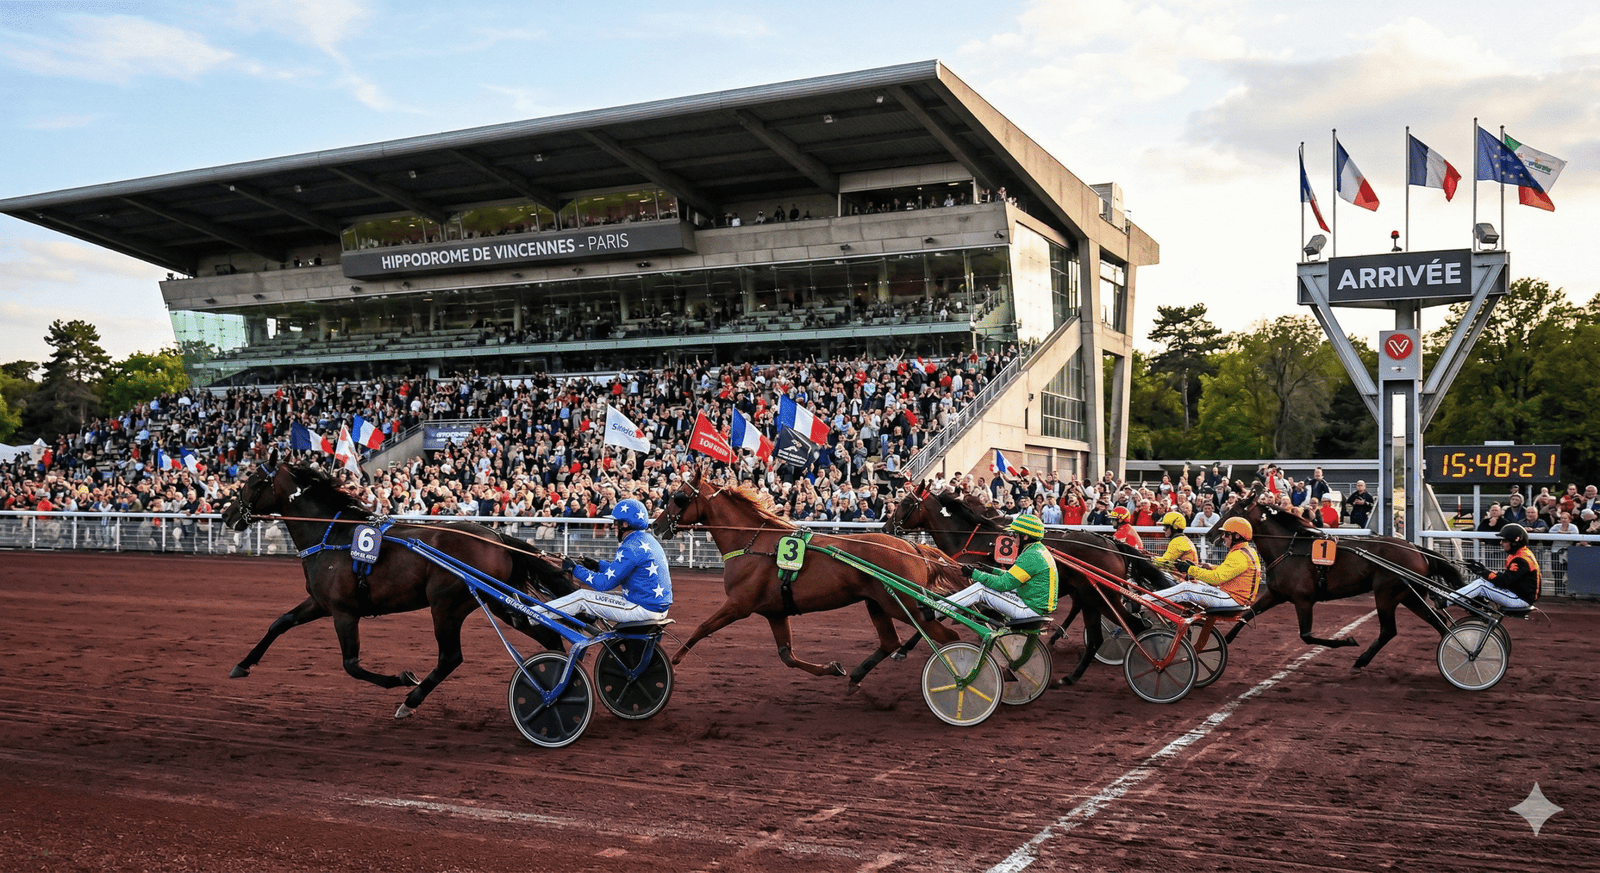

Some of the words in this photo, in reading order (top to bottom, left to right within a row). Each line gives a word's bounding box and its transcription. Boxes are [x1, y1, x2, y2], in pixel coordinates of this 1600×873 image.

[381, 248, 470, 270] HIPPODROME
[473, 246, 491, 262] DE
[493, 238, 575, 260] VINCENNES
[588, 232, 629, 251] PARIS
[1336, 258, 1462, 291] ARRIVÉE
[1442, 453, 1556, 478] 15:48:21
[357, 527, 376, 552] 6
[783, 539, 799, 561] 3
[999, 537, 1013, 557] 8
[1320, 541, 1328, 558] 1
